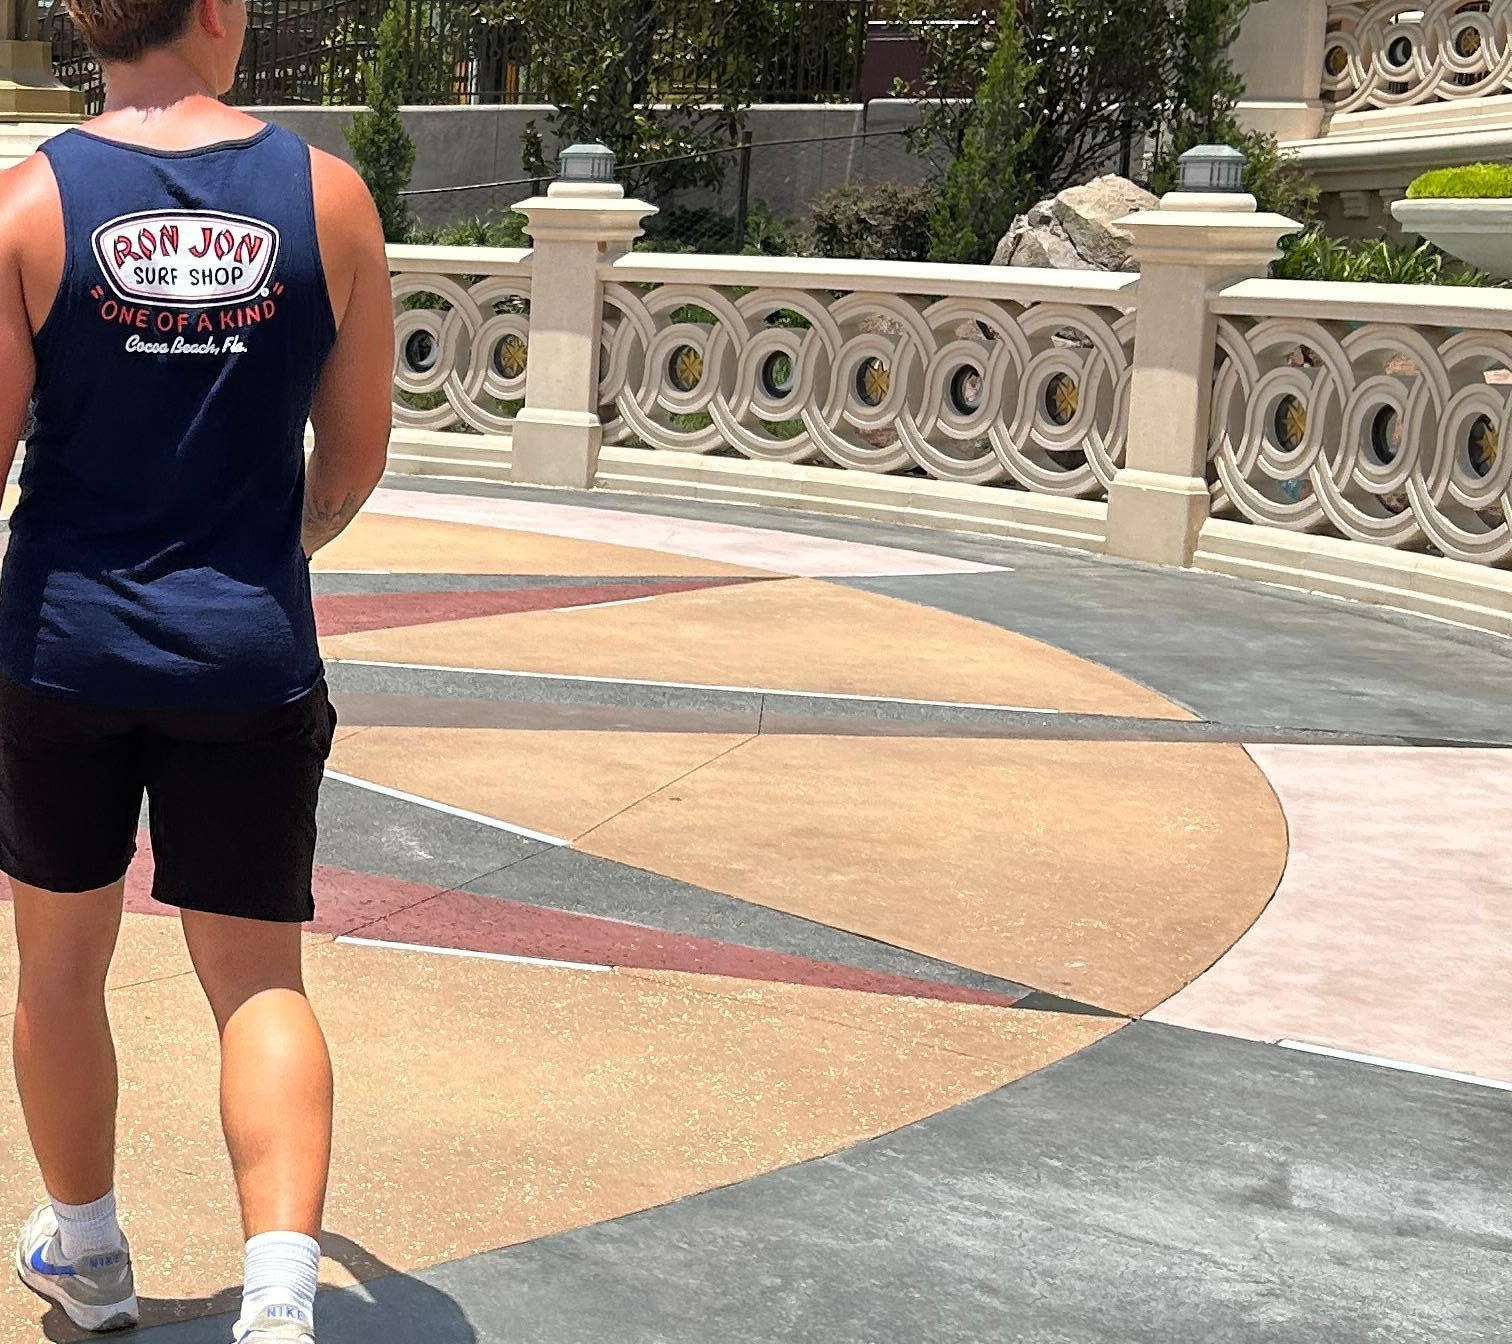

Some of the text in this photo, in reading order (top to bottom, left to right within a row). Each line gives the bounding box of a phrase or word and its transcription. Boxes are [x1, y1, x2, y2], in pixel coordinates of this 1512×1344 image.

[113, 224, 264, 269] RON JON
[134, 266, 244, 286] SURF SHOP
[157, 312, 191, 333] OF
[197, 313, 214, 333] A
[125, 334, 169, 353] Cocoa
[266, 1305, 306, 1321] NIKE
